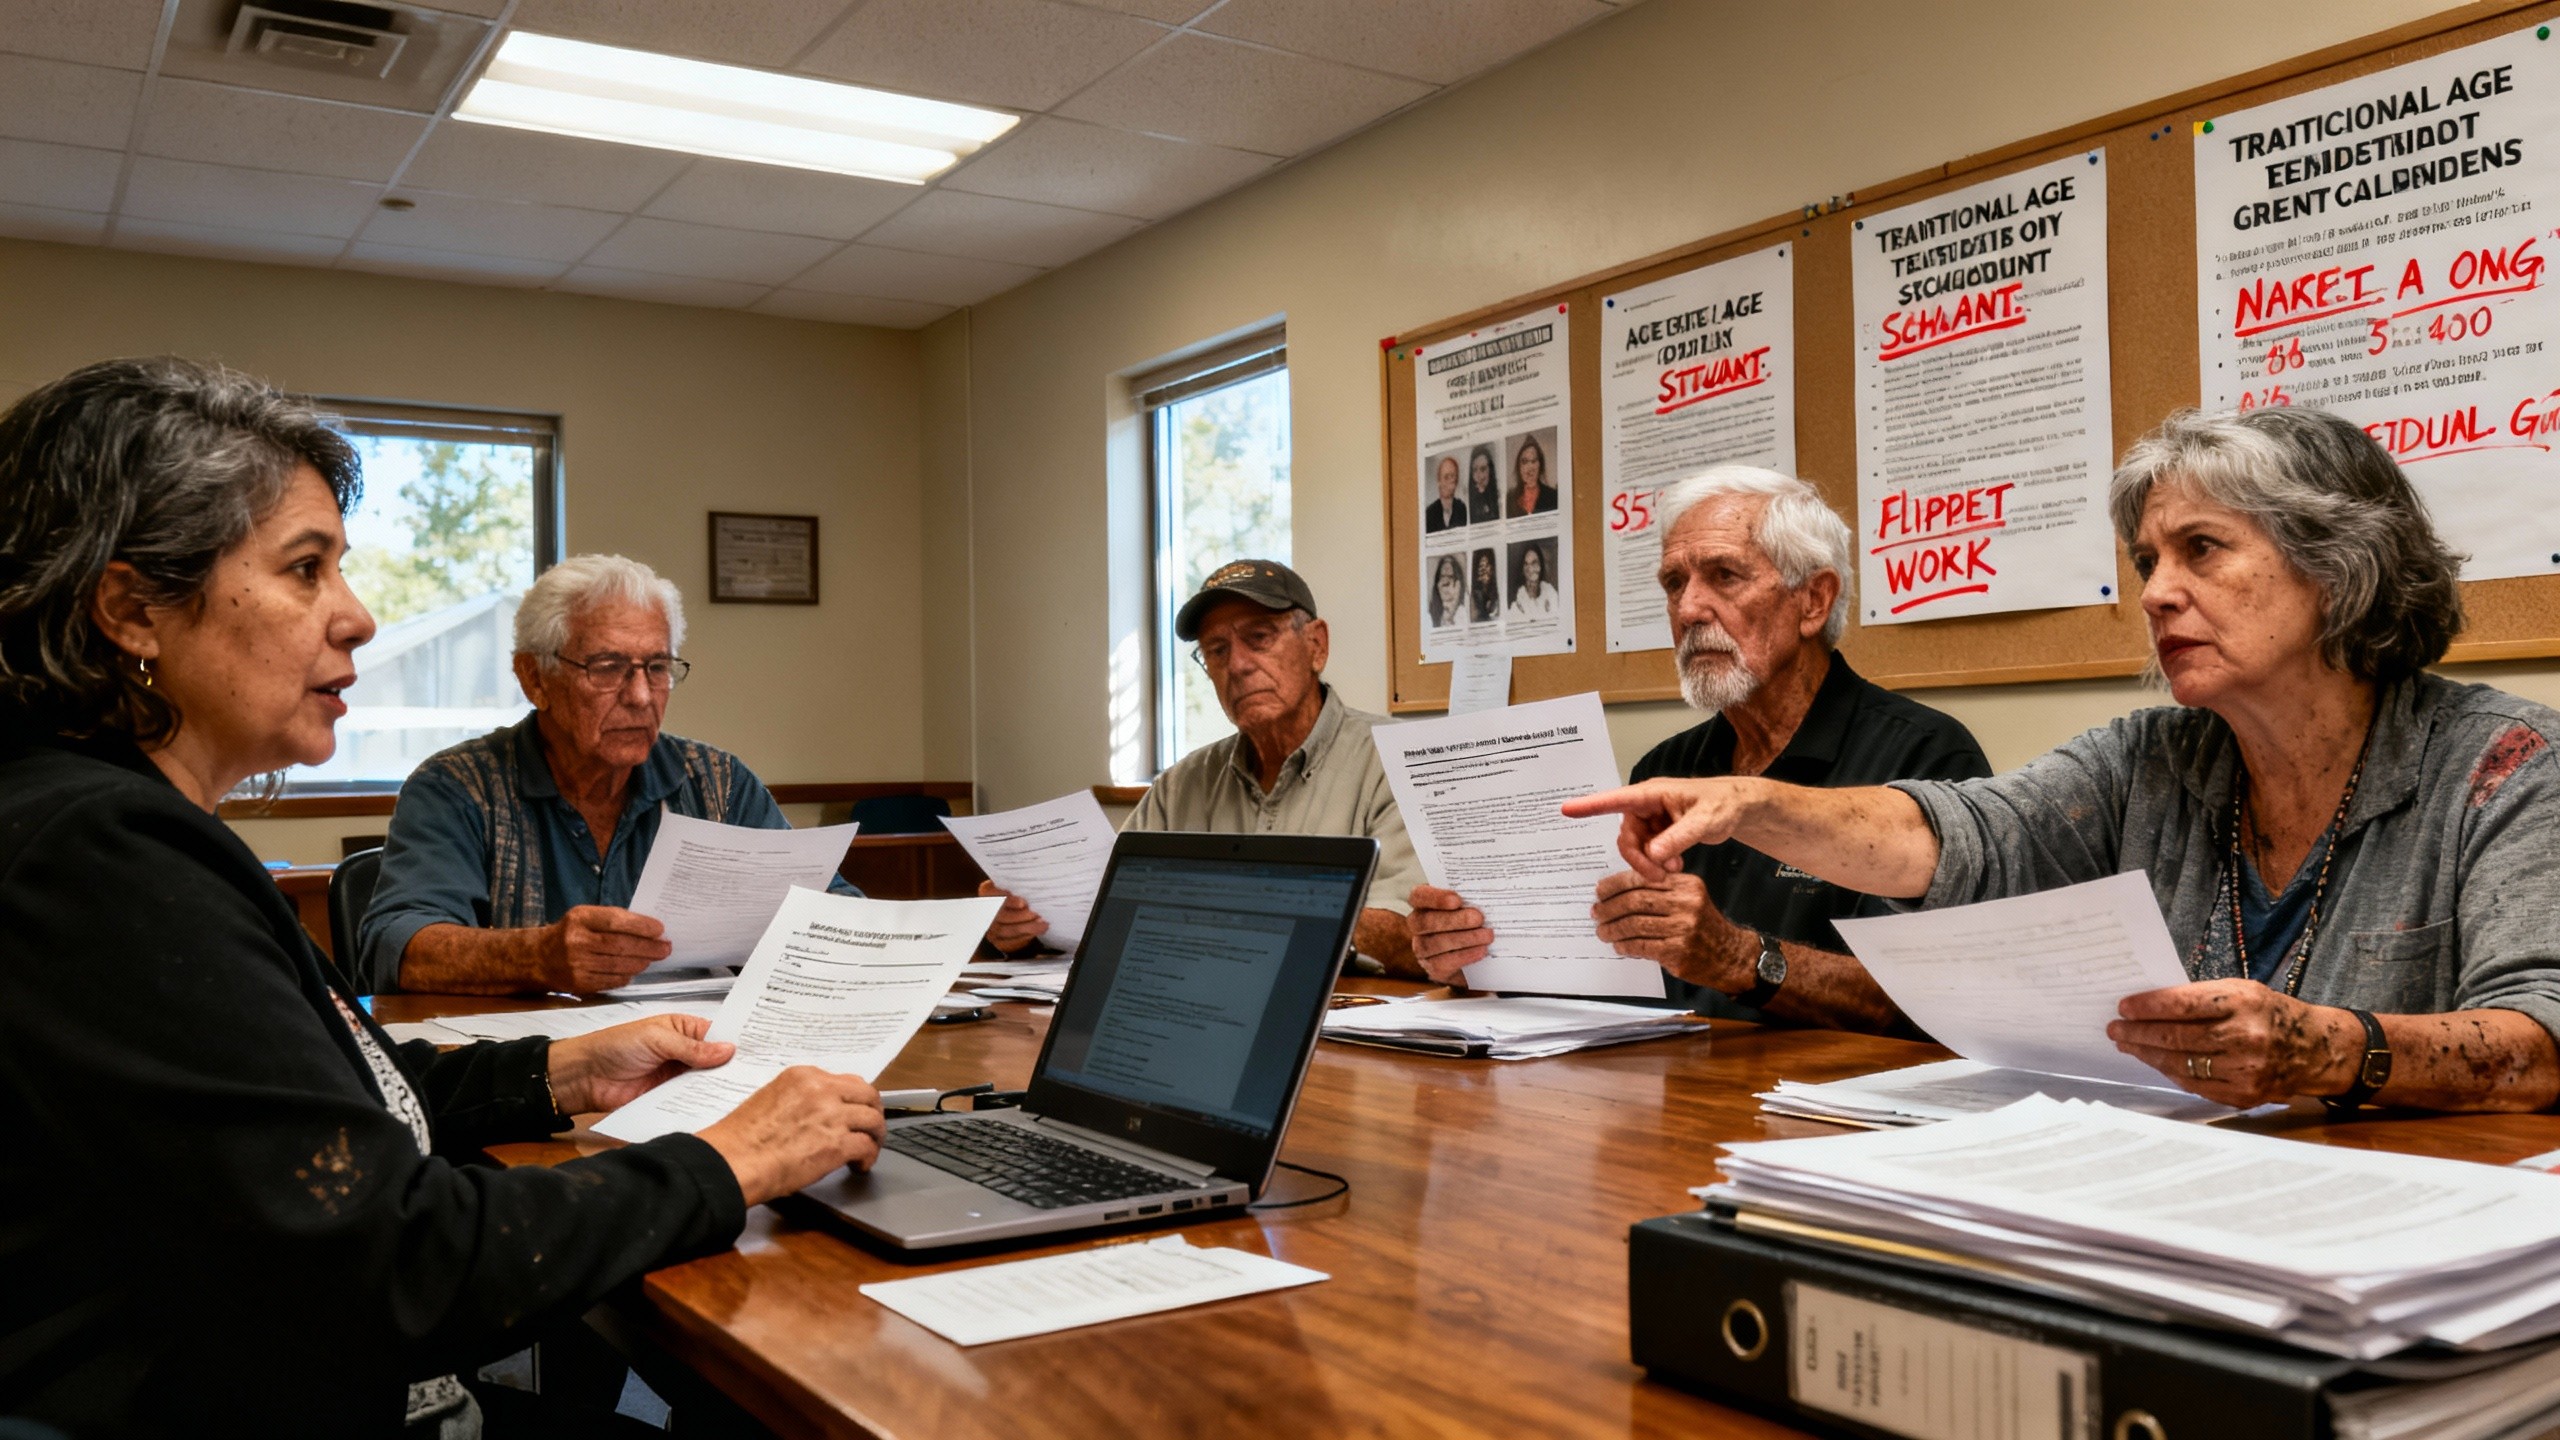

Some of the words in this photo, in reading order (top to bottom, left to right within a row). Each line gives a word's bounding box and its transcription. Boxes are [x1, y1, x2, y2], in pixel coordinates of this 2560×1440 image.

[2446, 65, 2513, 106] AGE
[2024, 176, 2076, 210] AGE
[2233, 187, 2331, 230] GRENT
